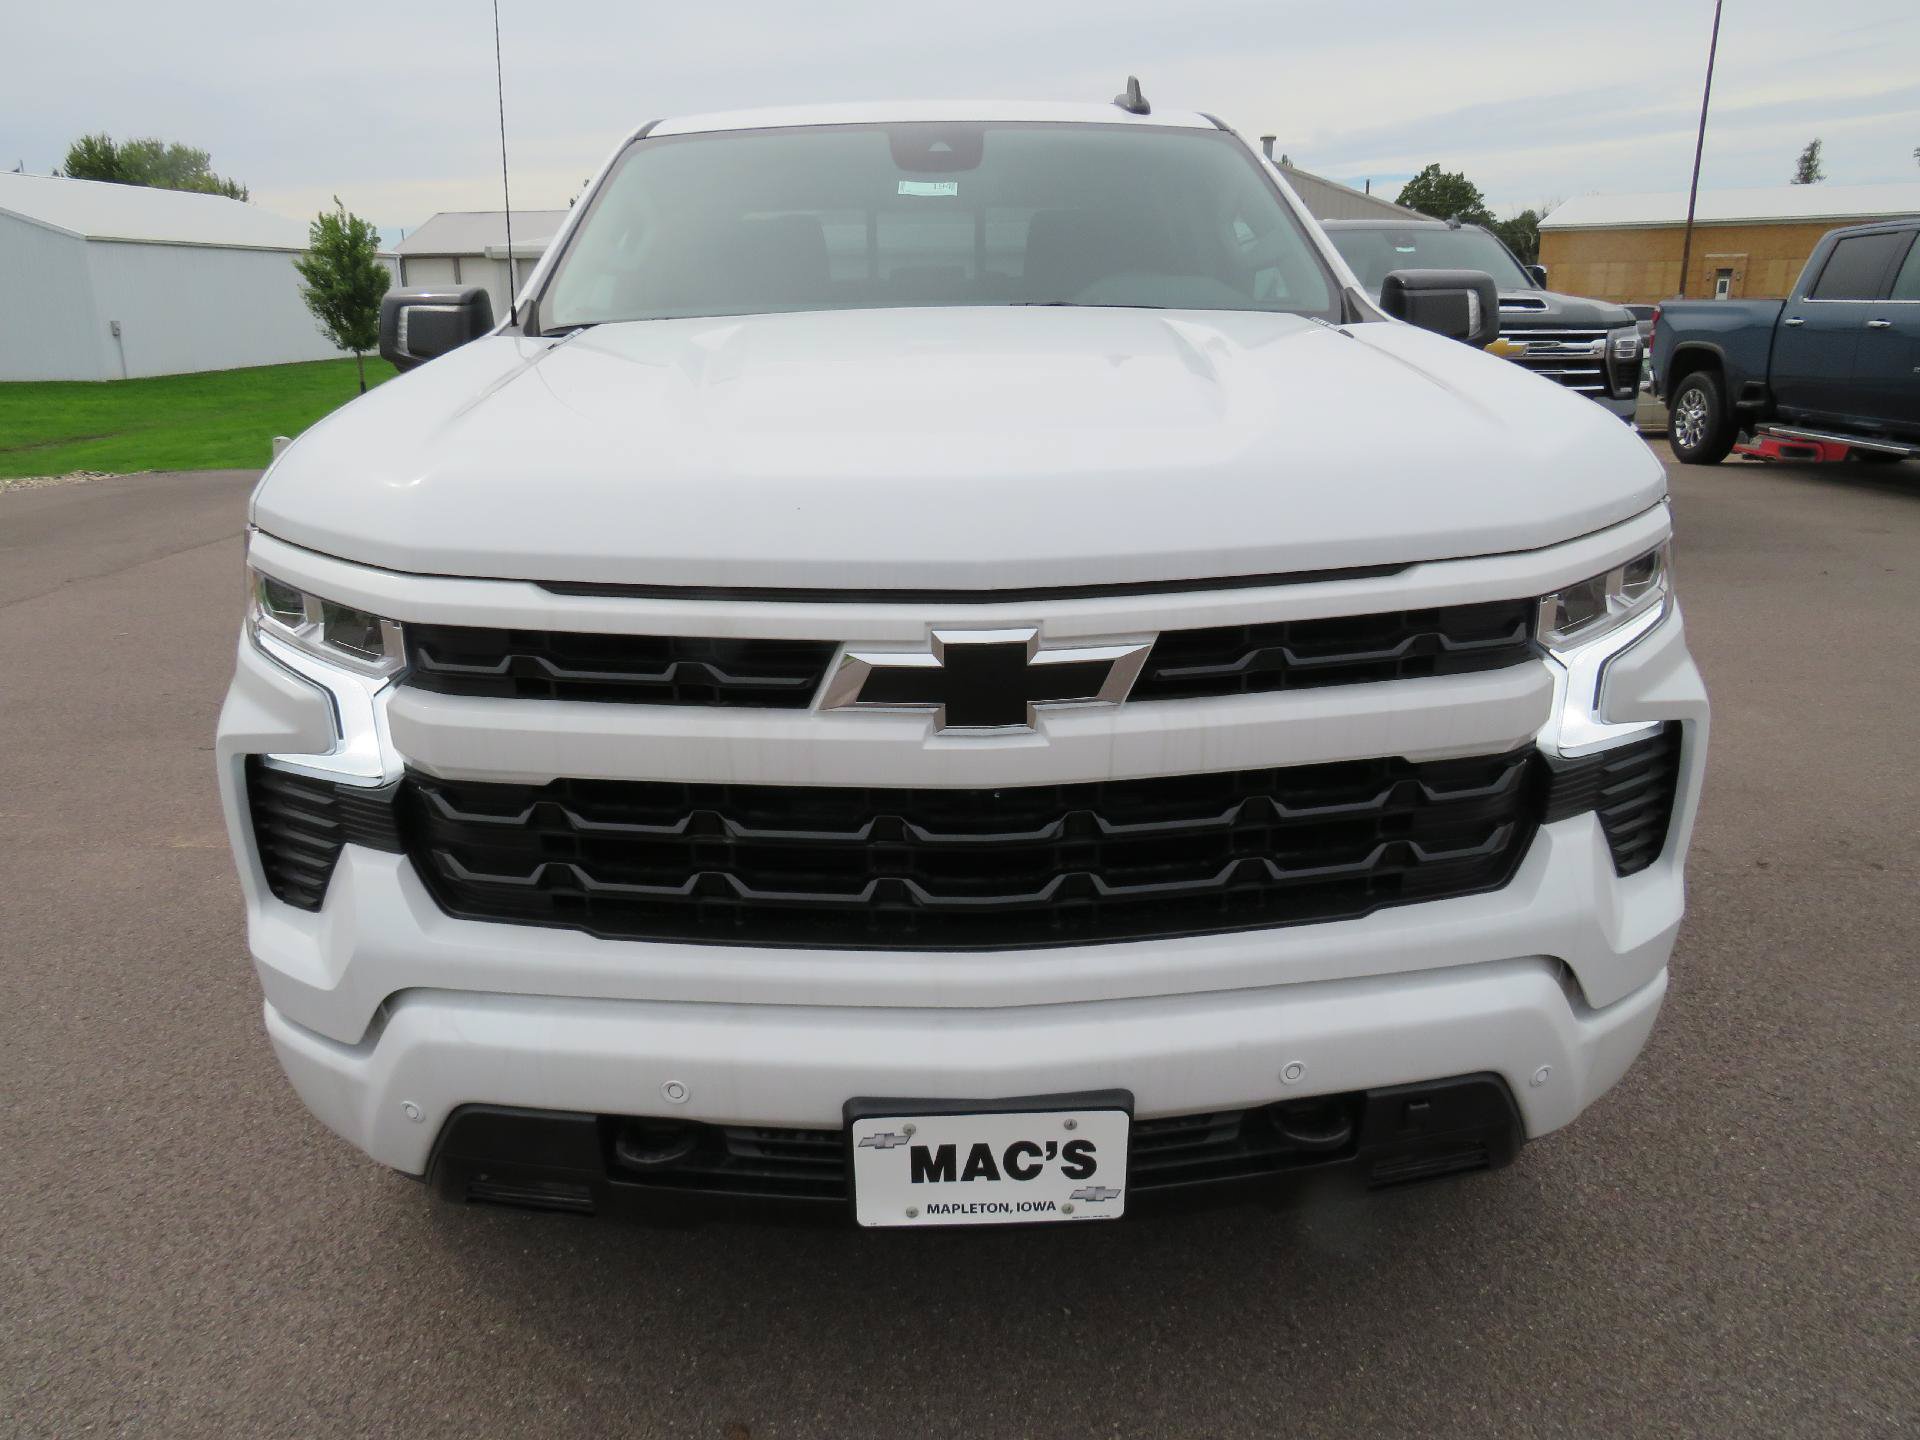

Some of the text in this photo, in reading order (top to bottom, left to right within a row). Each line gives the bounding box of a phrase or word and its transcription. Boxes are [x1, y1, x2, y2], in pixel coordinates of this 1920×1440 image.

[910, 1139, 1098, 1184] MAC'S
[926, 1200, 1057, 1215] MAPLETON, IOWA
